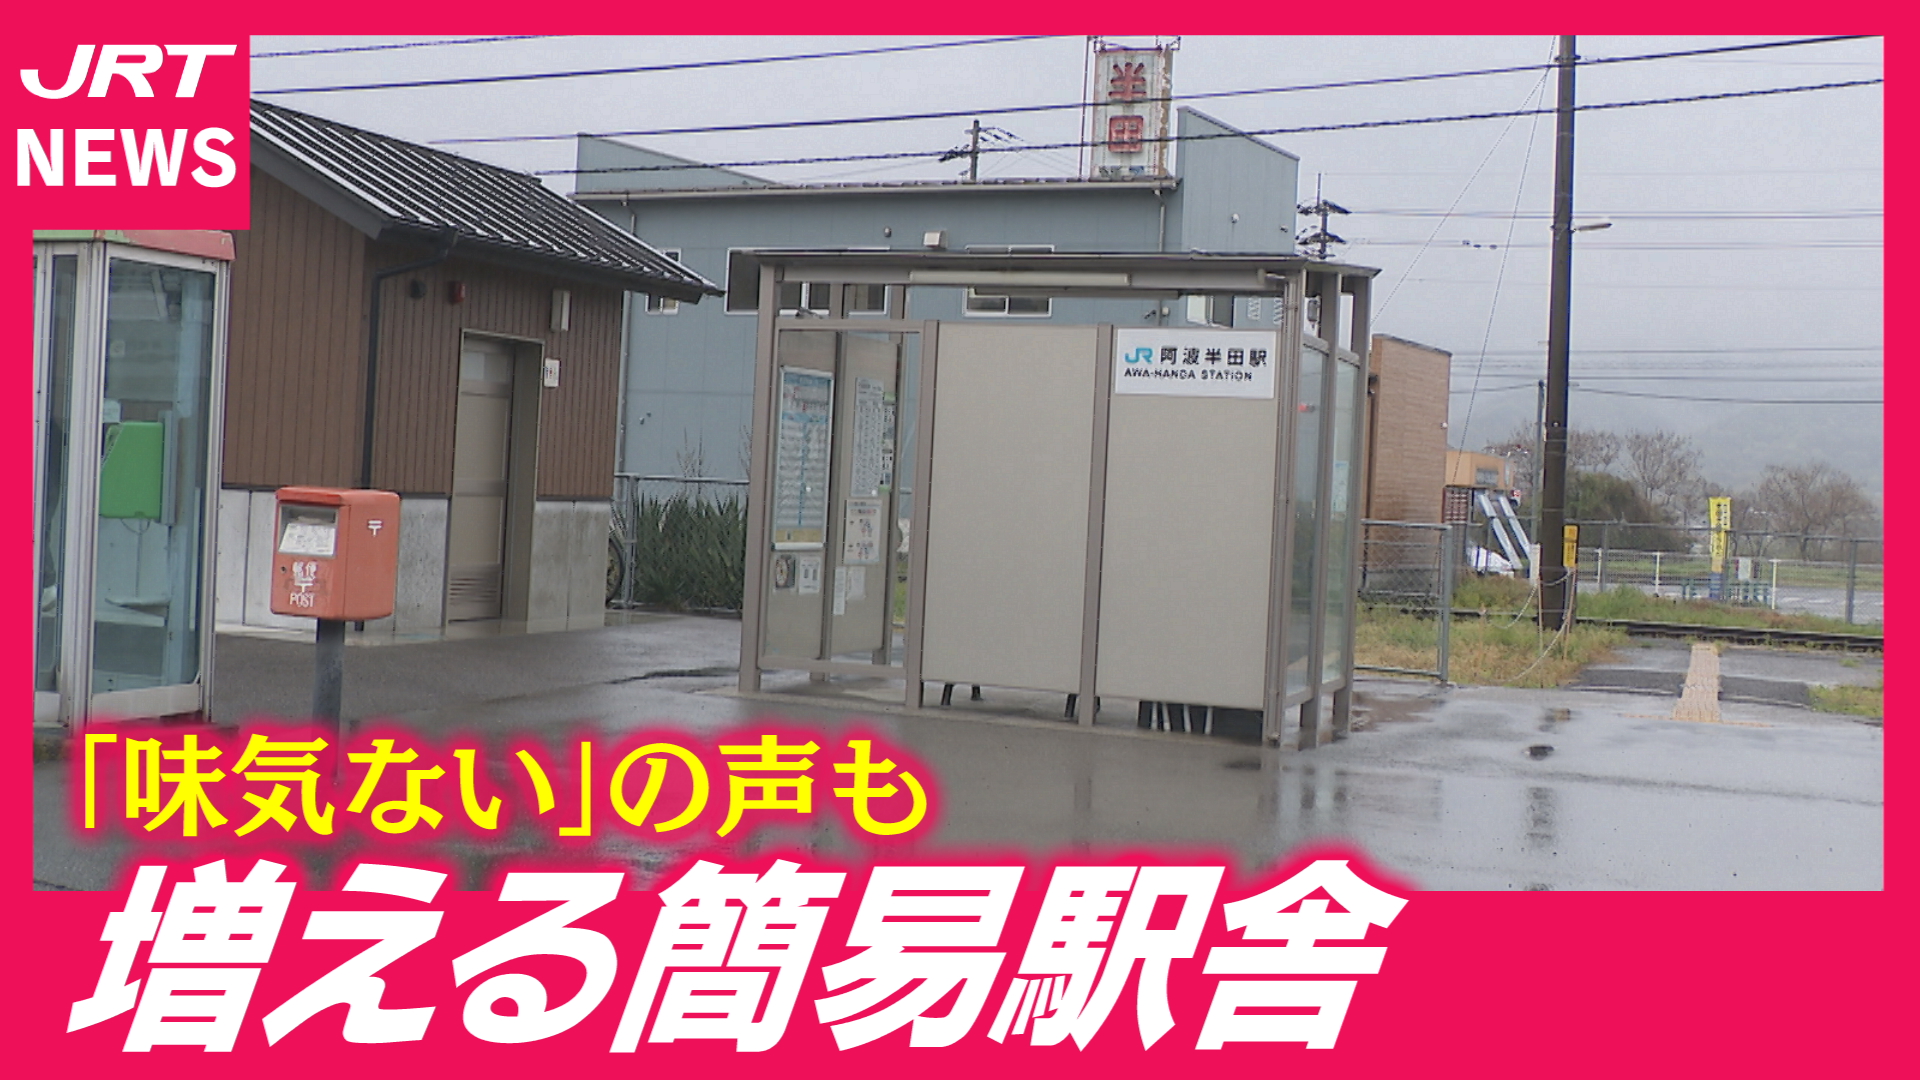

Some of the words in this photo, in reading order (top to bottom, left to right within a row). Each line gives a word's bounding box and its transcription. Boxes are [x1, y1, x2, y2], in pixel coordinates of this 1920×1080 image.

[1108, 61, 1147, 154] 半田
[1124, 347, 1154, 364] JR
[1160, 345, 1268, 367] 阿波半田駅
[1124, 367, 1196, 380] AWA-HANDA
[1201, 369, 1252, 382] STATION
[289, 592, 314, 608] POST
